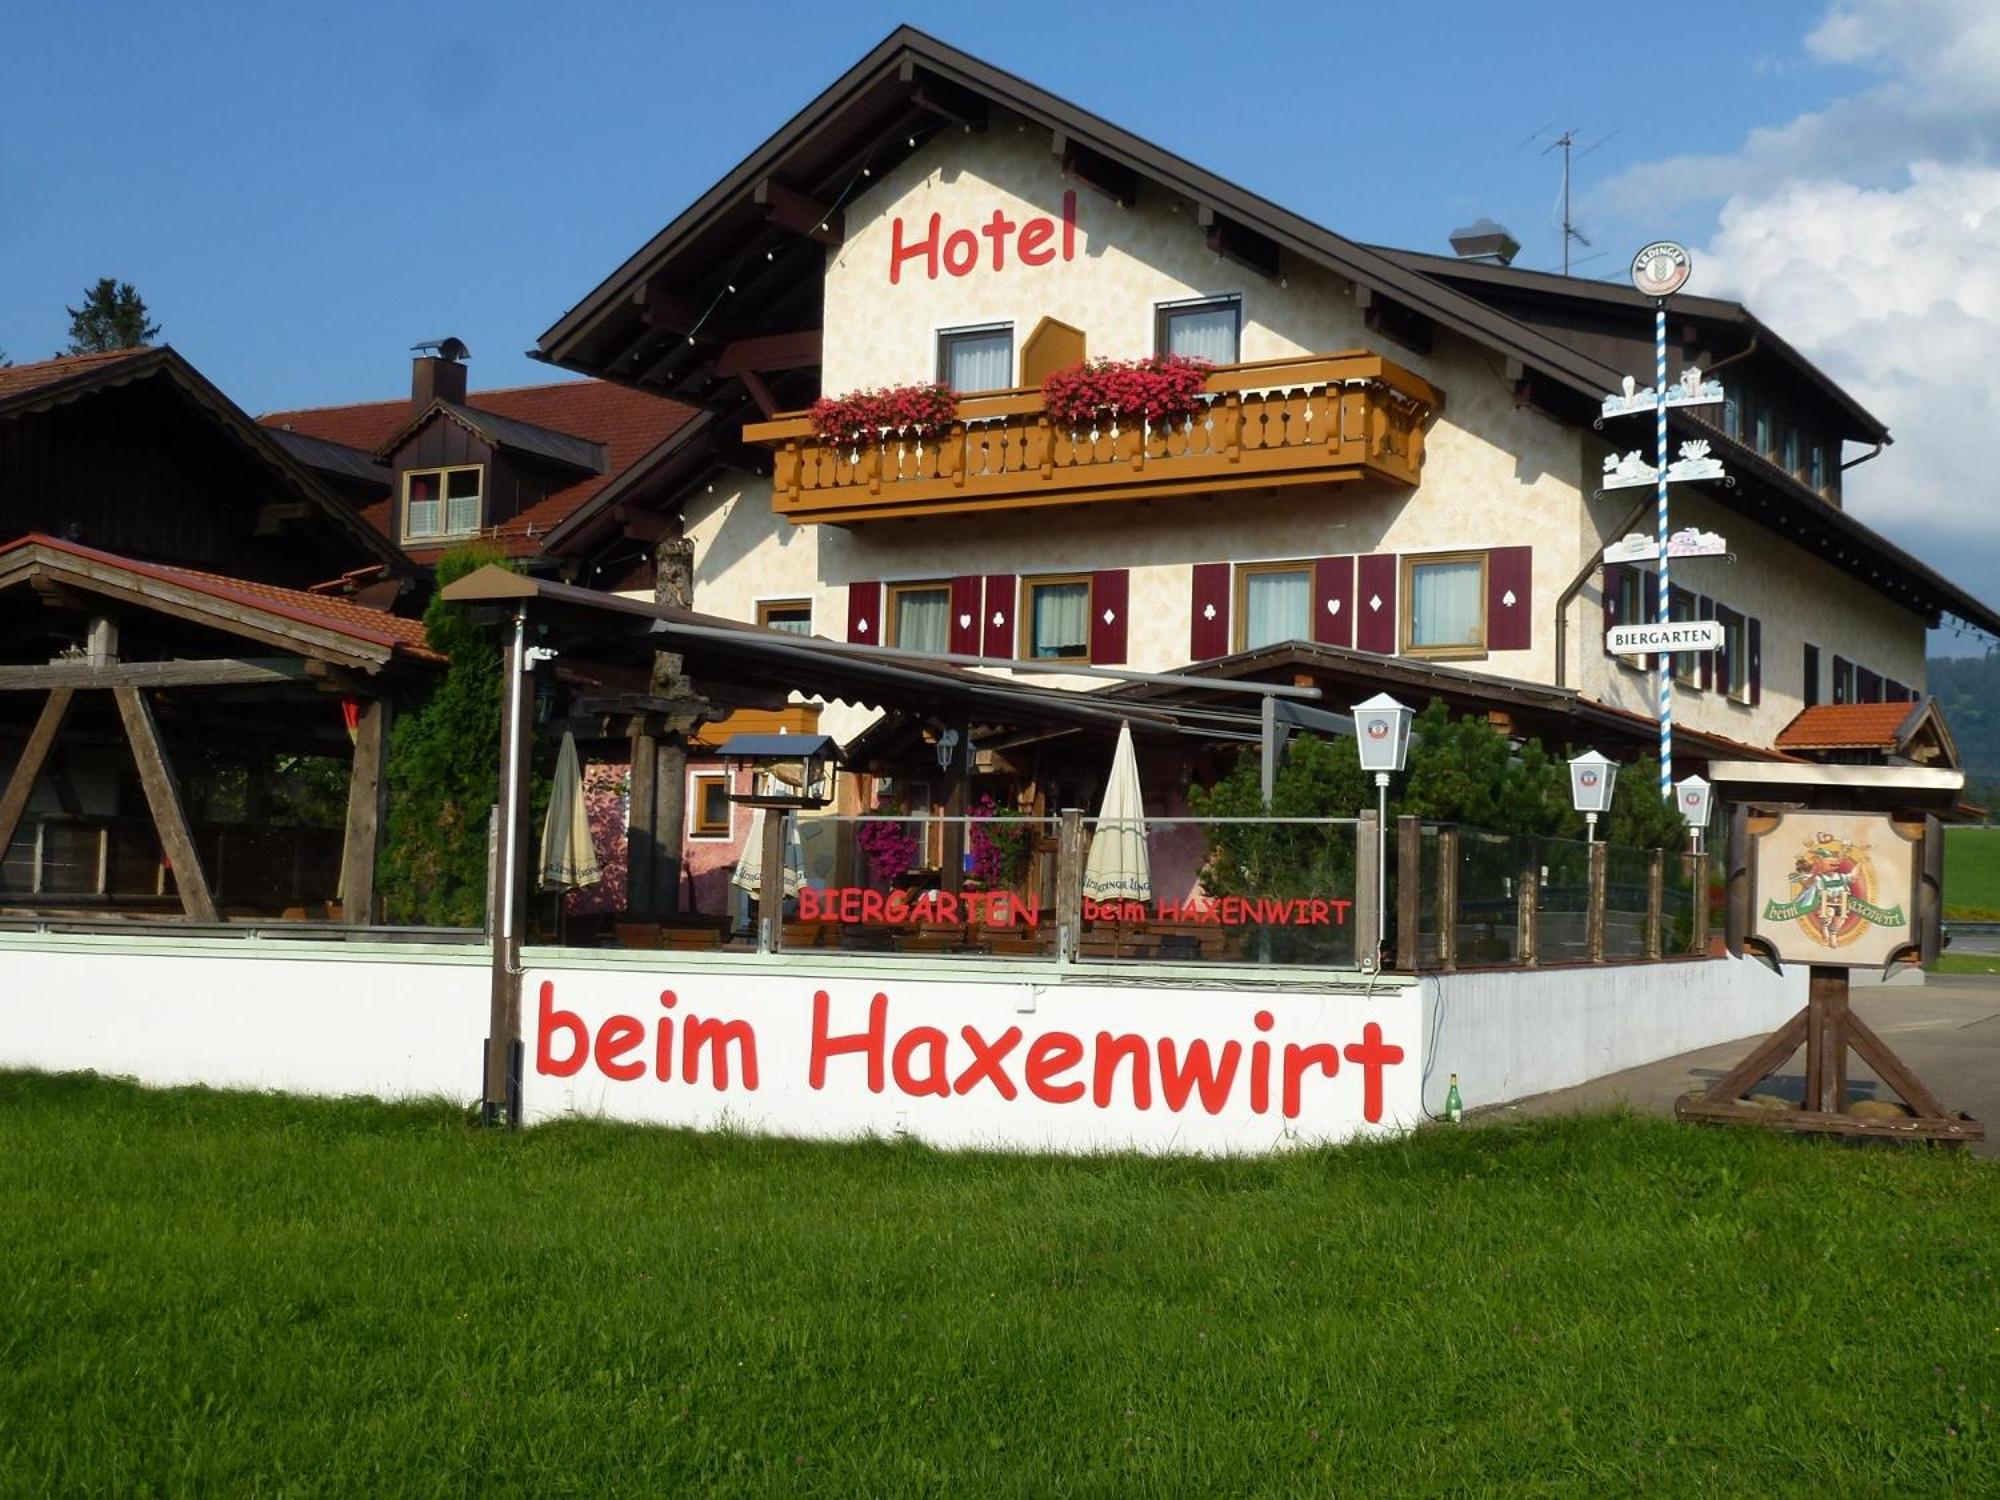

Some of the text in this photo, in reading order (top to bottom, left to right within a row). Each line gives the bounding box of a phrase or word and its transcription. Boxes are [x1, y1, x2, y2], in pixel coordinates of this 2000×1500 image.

[889, 190, 1077, 285] Hotel
[1638, 246, 1684, 268] ERDINGER
[1615, 629, 1712, 646] BIERGARTEN
[799, 886, 1041, 928] BIERGARTEN
[1083, 895, 1352, 926] beim HAXENWIRT
[1767, 904, 1799, 921] beim
[535, 981, 1404, 1123] beim Haxenwirt
